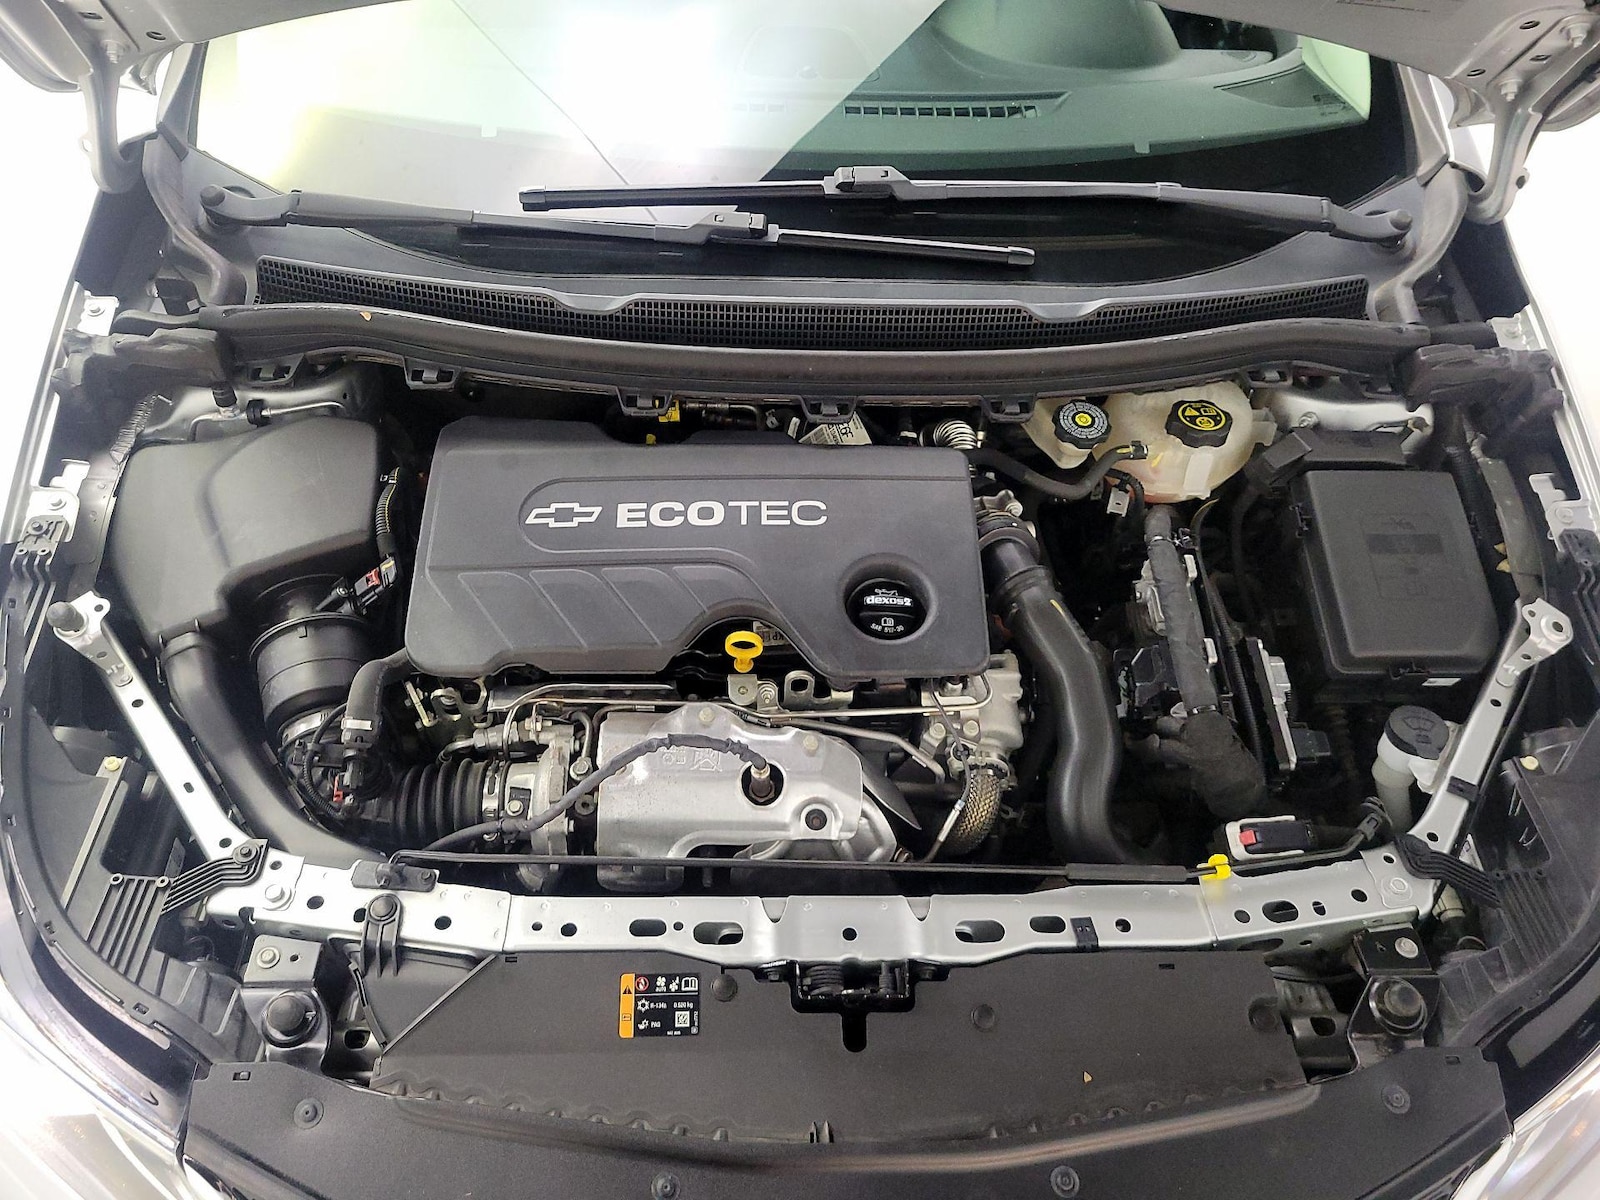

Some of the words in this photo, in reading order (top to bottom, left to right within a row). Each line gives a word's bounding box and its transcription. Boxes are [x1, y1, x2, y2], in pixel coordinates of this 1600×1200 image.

[616, 500, 828, 528] ECOTEC
[865, 595, 912, 606] dexos2
[870, 623, 882, 632] SAE
